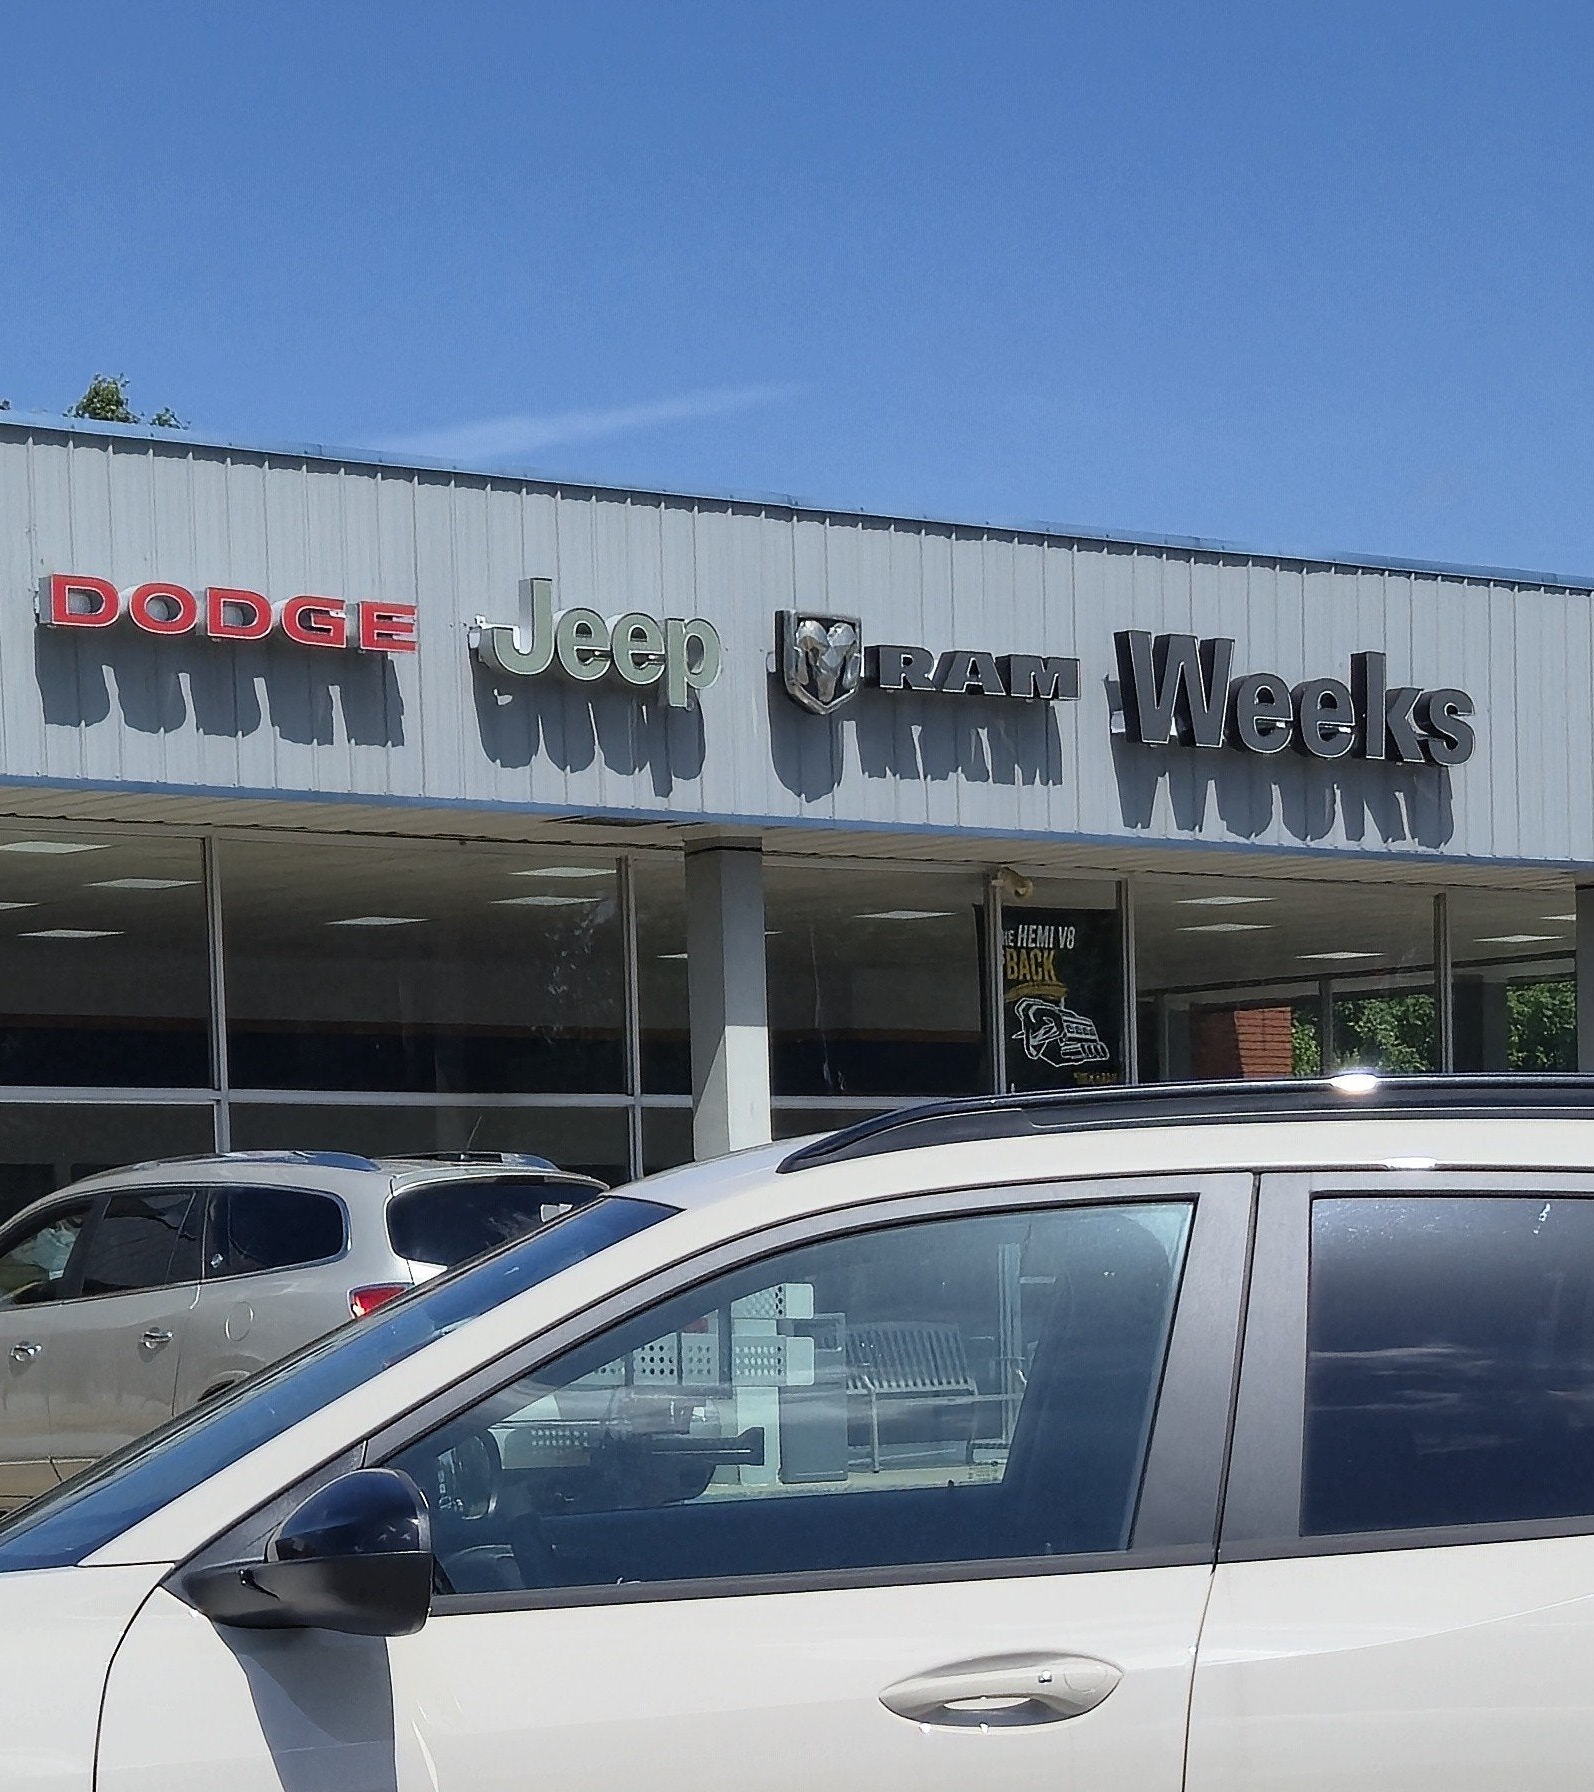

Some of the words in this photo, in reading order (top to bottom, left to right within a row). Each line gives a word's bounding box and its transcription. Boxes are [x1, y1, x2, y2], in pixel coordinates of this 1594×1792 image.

[45, 573, 418, 654] DODGE
[480, 577, 722, 708] Jeep
[865, 645, 1081, 700] RAM
[1113, 629, 1476, 766] Weeks
[1005, 948, 1057, 982] BACK
[1017, 924, 1055, 949] HEMI
[1058, 926, 1076, 950] V8
